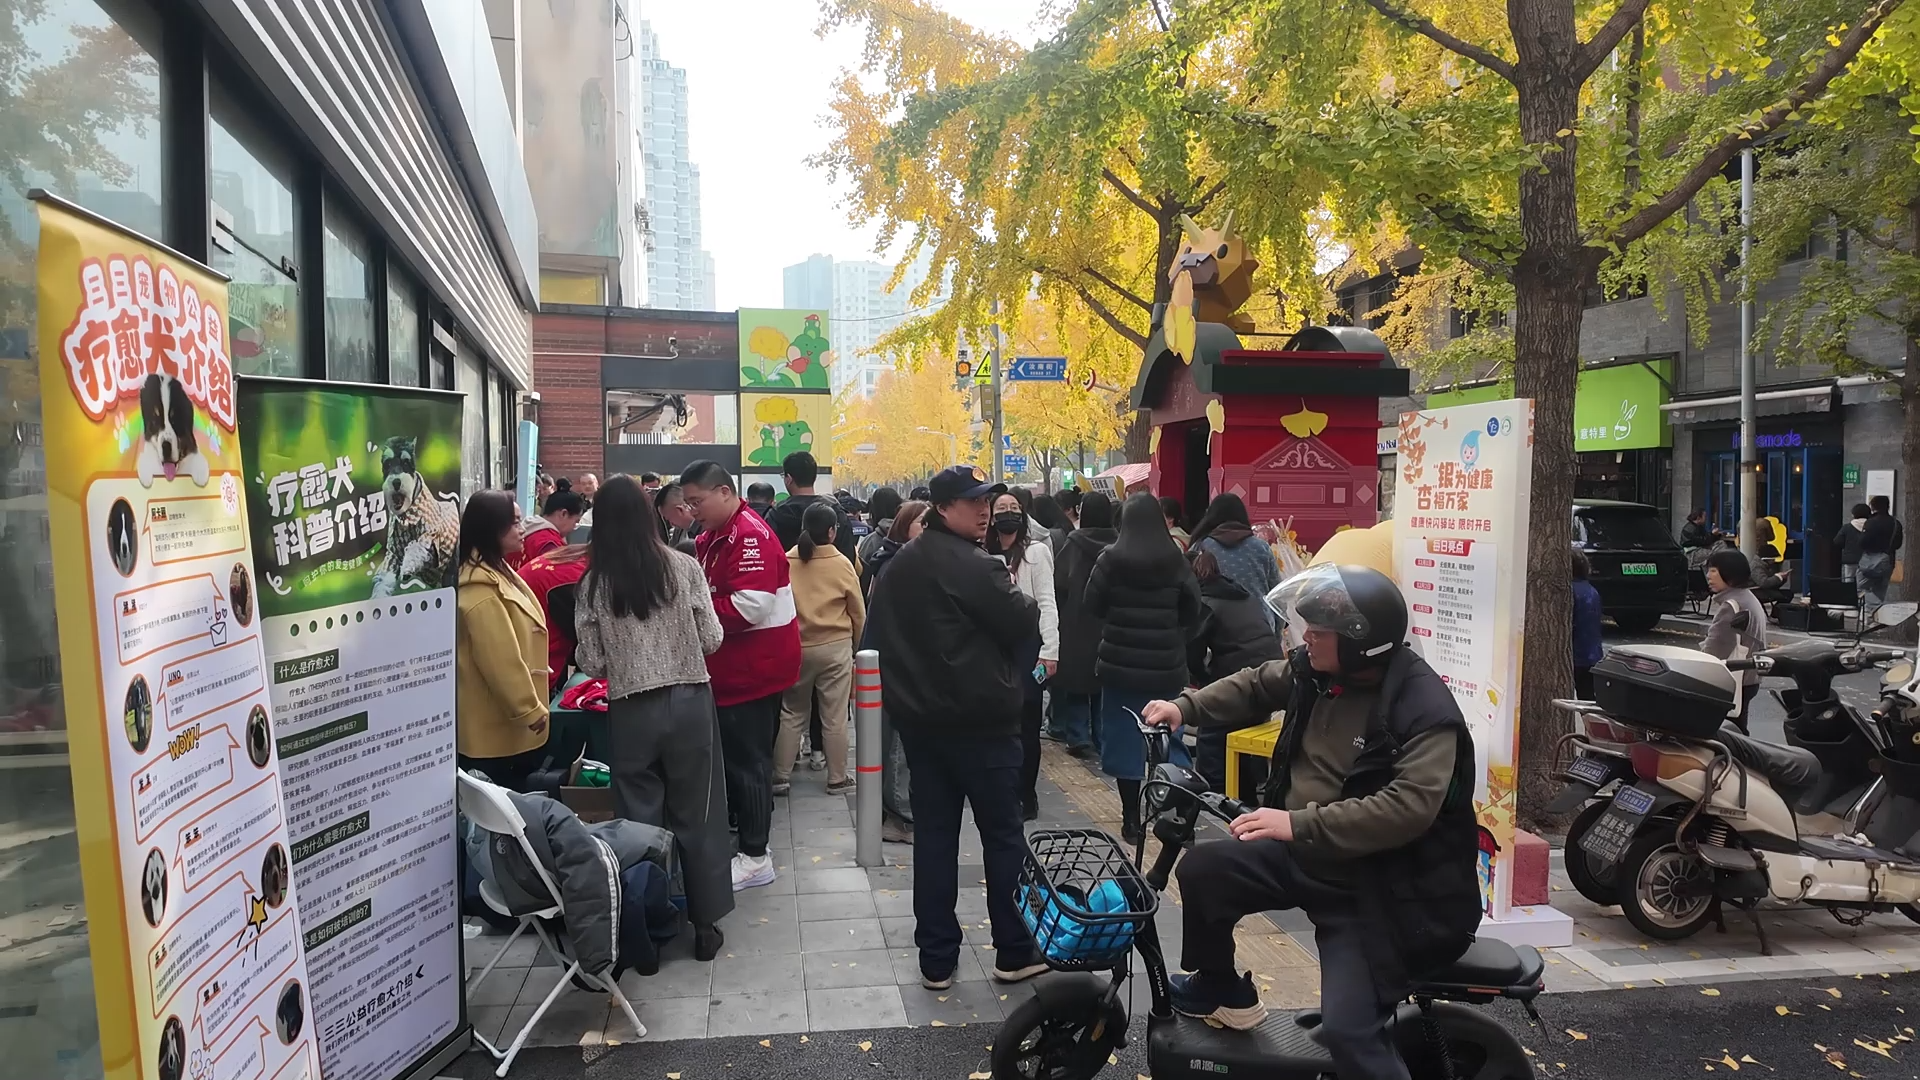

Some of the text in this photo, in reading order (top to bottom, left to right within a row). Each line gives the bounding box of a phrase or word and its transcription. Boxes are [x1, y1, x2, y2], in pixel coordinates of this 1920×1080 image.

[71, 307, 232, 417] 疗愈犬介绍
[267, 455, 354, 518] 疗愈犬
[1846, 471, 1858, 479] 468
[272, 491, 388, 567] 科普介绍
[1410, 516, 1492, 532] 健康快闪驿站 限时开启
[1432, 540, 1465, 554] 每日亮点
[168, 669, 182, 683] UNO
[279, 654, 335, 680] 什么是疗愈犬?
[167, 722, 200, 761] WOW!
[1154, 966, 1165, 997] LUYUAN
[324, 972, 413, 1042] 三三公益疗愈犬介绍
